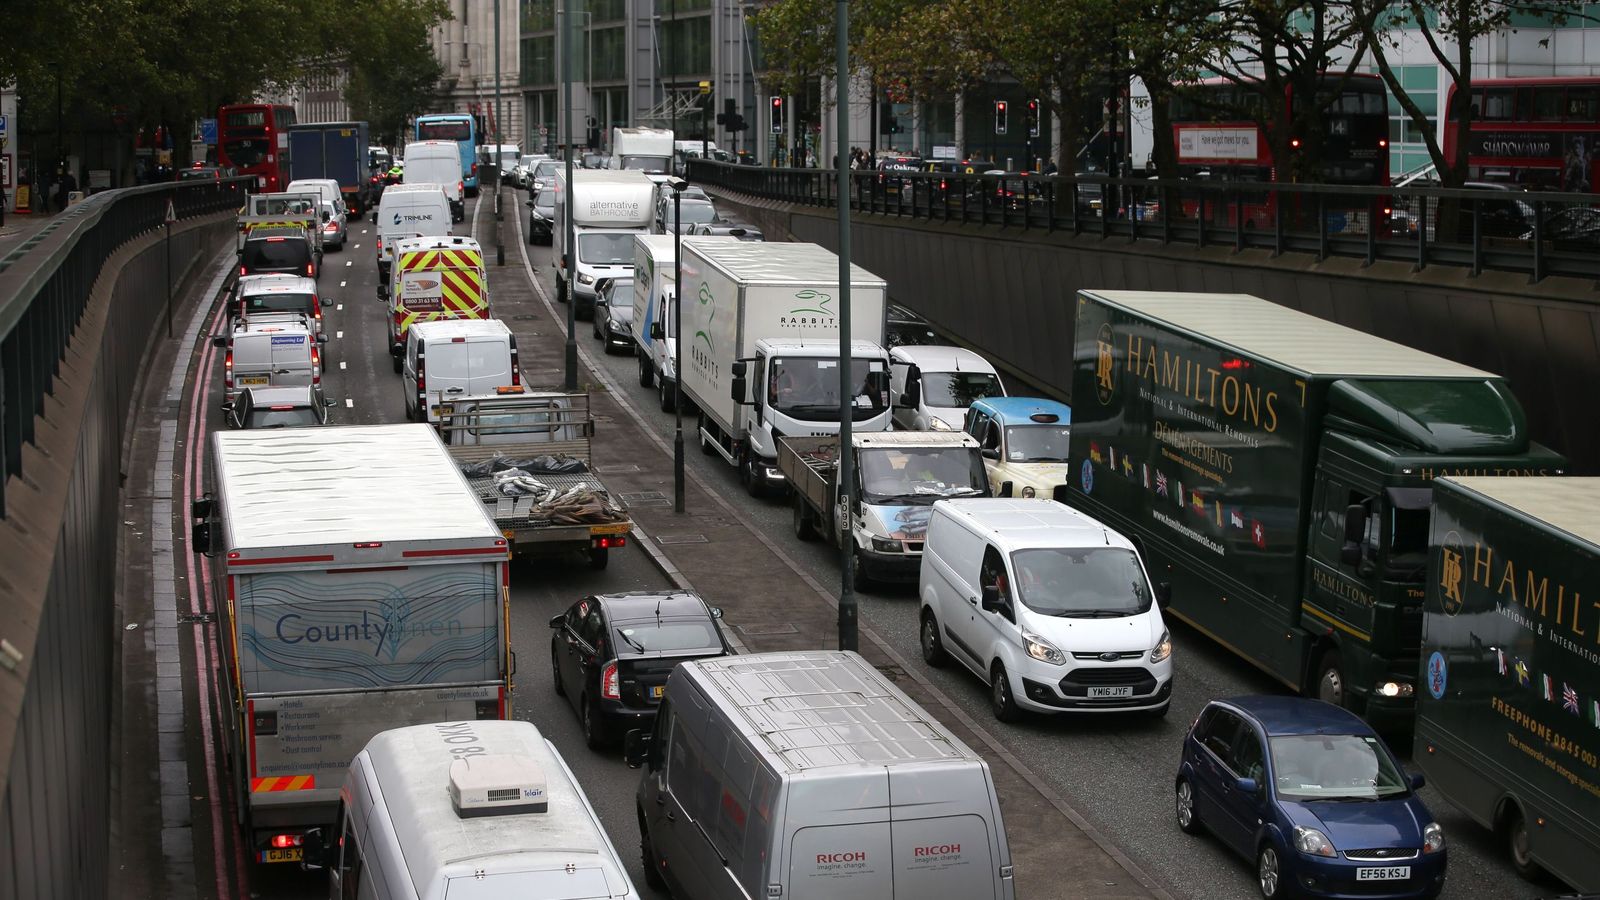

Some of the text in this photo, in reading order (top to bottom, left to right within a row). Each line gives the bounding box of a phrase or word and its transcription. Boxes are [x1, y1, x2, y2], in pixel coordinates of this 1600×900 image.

[1330, 120, 1344, 134] 14
[1482, 142, 1524, 156] SHADOW
[1528, 142, 1551, 156] WAR
[590, 201, 638, 210] alternative
[692, 345, 718, 379] RABBITS
[1127, 333, 1278, 433] HAMILTONS
[1422, 468, 1549, 480] HAMILTONS
[1152, 509, 1225, 557] www.hamiltonsremovals.co.uk
[1312, 567, 1375, 609] HAMILTONS
[1537, 623, 1544, 636] &
[437, 688, 489, 700] countylinen.co.uk
[1092, 688, 1128, 696] YM16 JYF
[284, 700, 304, 708] Hotels
[284, 711, 320, 720] Restaurants
[1492, 695, 1552, 743] FREEPHONE
[1553, 733, 1580, 759] 0845
[285, 733, 342, 742] Washroom services
[286, 744, 322, 754] Dust control
[1507, 733, 1518, 748] The
[1519, 742, 1544, 764] removals
[1545, 757, 1556, 770] and
[1556, 764, 1579, 784] storage
[261, 760, 352, 772] enquiries@countylinen.co.u
[524, 789, 543, 798] Telair
[270, 850, 292, 859] GJ16
[915, 844, 961, 856] RICOH
[816, 852, 866, 863] RICOH
[915, 855, 939, 865] imagine.
[817, 863, 843, 871] imagine.
[1360, 867, 1408, 880] EF56 KSJ
